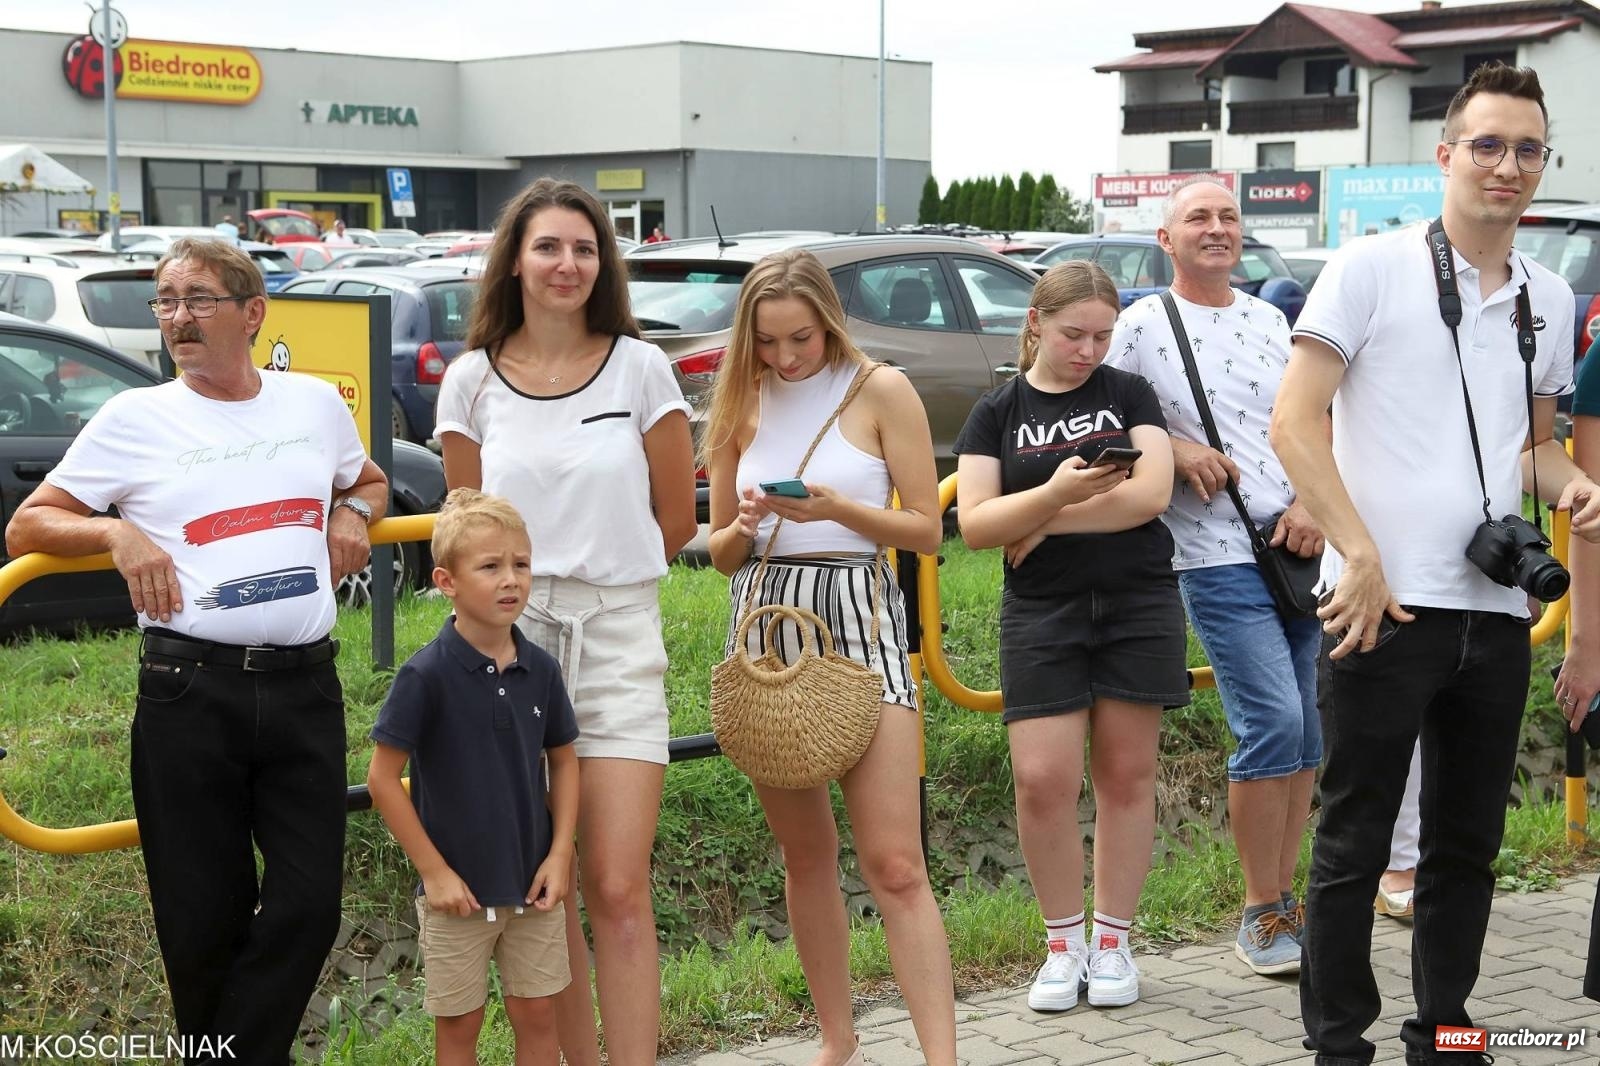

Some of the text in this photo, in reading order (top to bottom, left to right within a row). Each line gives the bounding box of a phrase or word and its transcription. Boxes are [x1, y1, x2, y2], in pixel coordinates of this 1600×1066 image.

[128, 51, 250, 79] Biedronka
[128, 74, 250, 94] Codziennie niskie ceny
[327, 103, 418, 126] APTEKA
[392, 171, 407, 192] P
[1102, 180, 1147, 195] MEBLE
[1249, 186, 1296, 199] LIDEX
[1343, 174, 1445, 194] max ELEKT
[1435, 241, 1451, 280] SONY
[1017, 409, 1123, 448] NASA
[177, 436, 310, 475] The best jeans
[211, 502, 306, 537] Calm down
[239, 575, 303, 604] Couture
